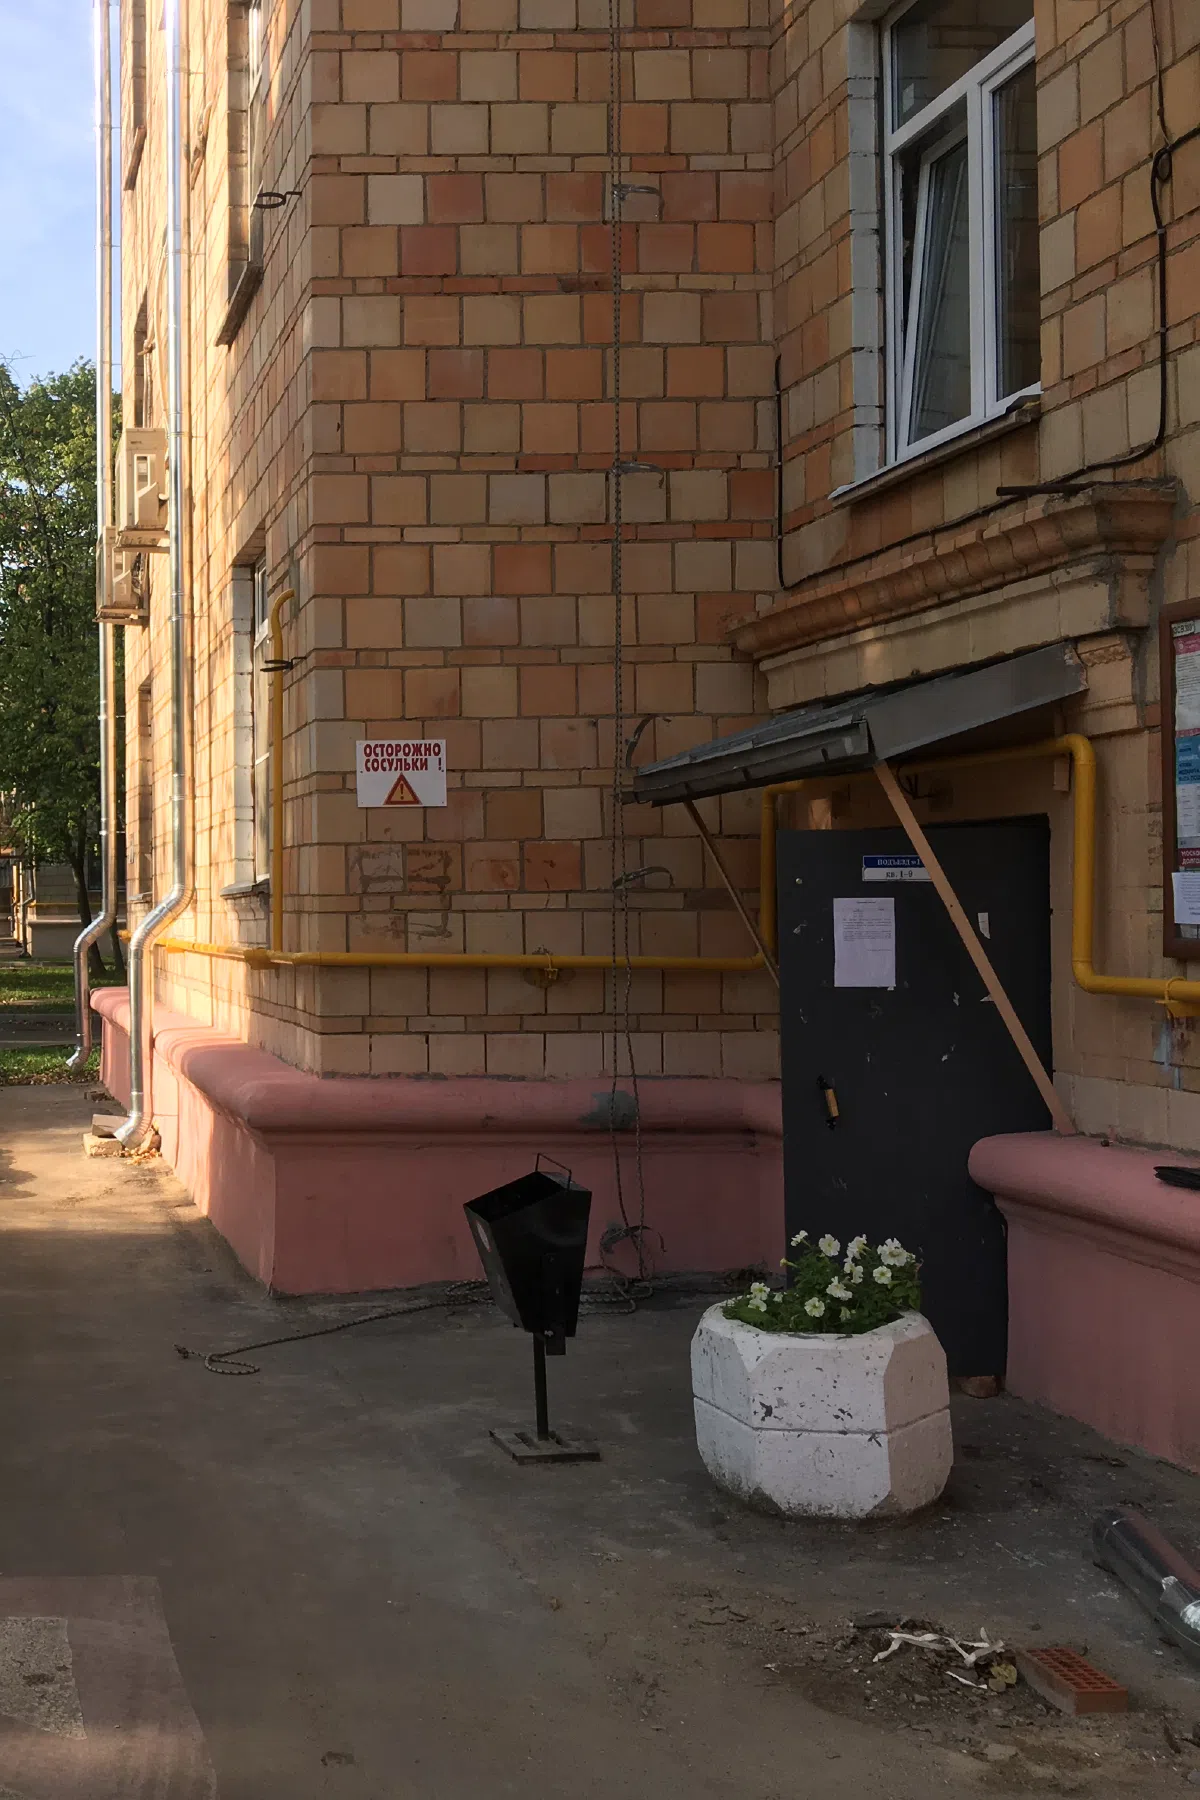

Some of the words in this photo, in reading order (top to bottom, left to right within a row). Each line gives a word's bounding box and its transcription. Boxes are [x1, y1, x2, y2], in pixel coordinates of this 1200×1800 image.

[363, 743, 441, 757] ОСТОРОЖНО
[364, 758, 428, 772] СОСУЛЬКИ
[438, 757, 442, 771] !
